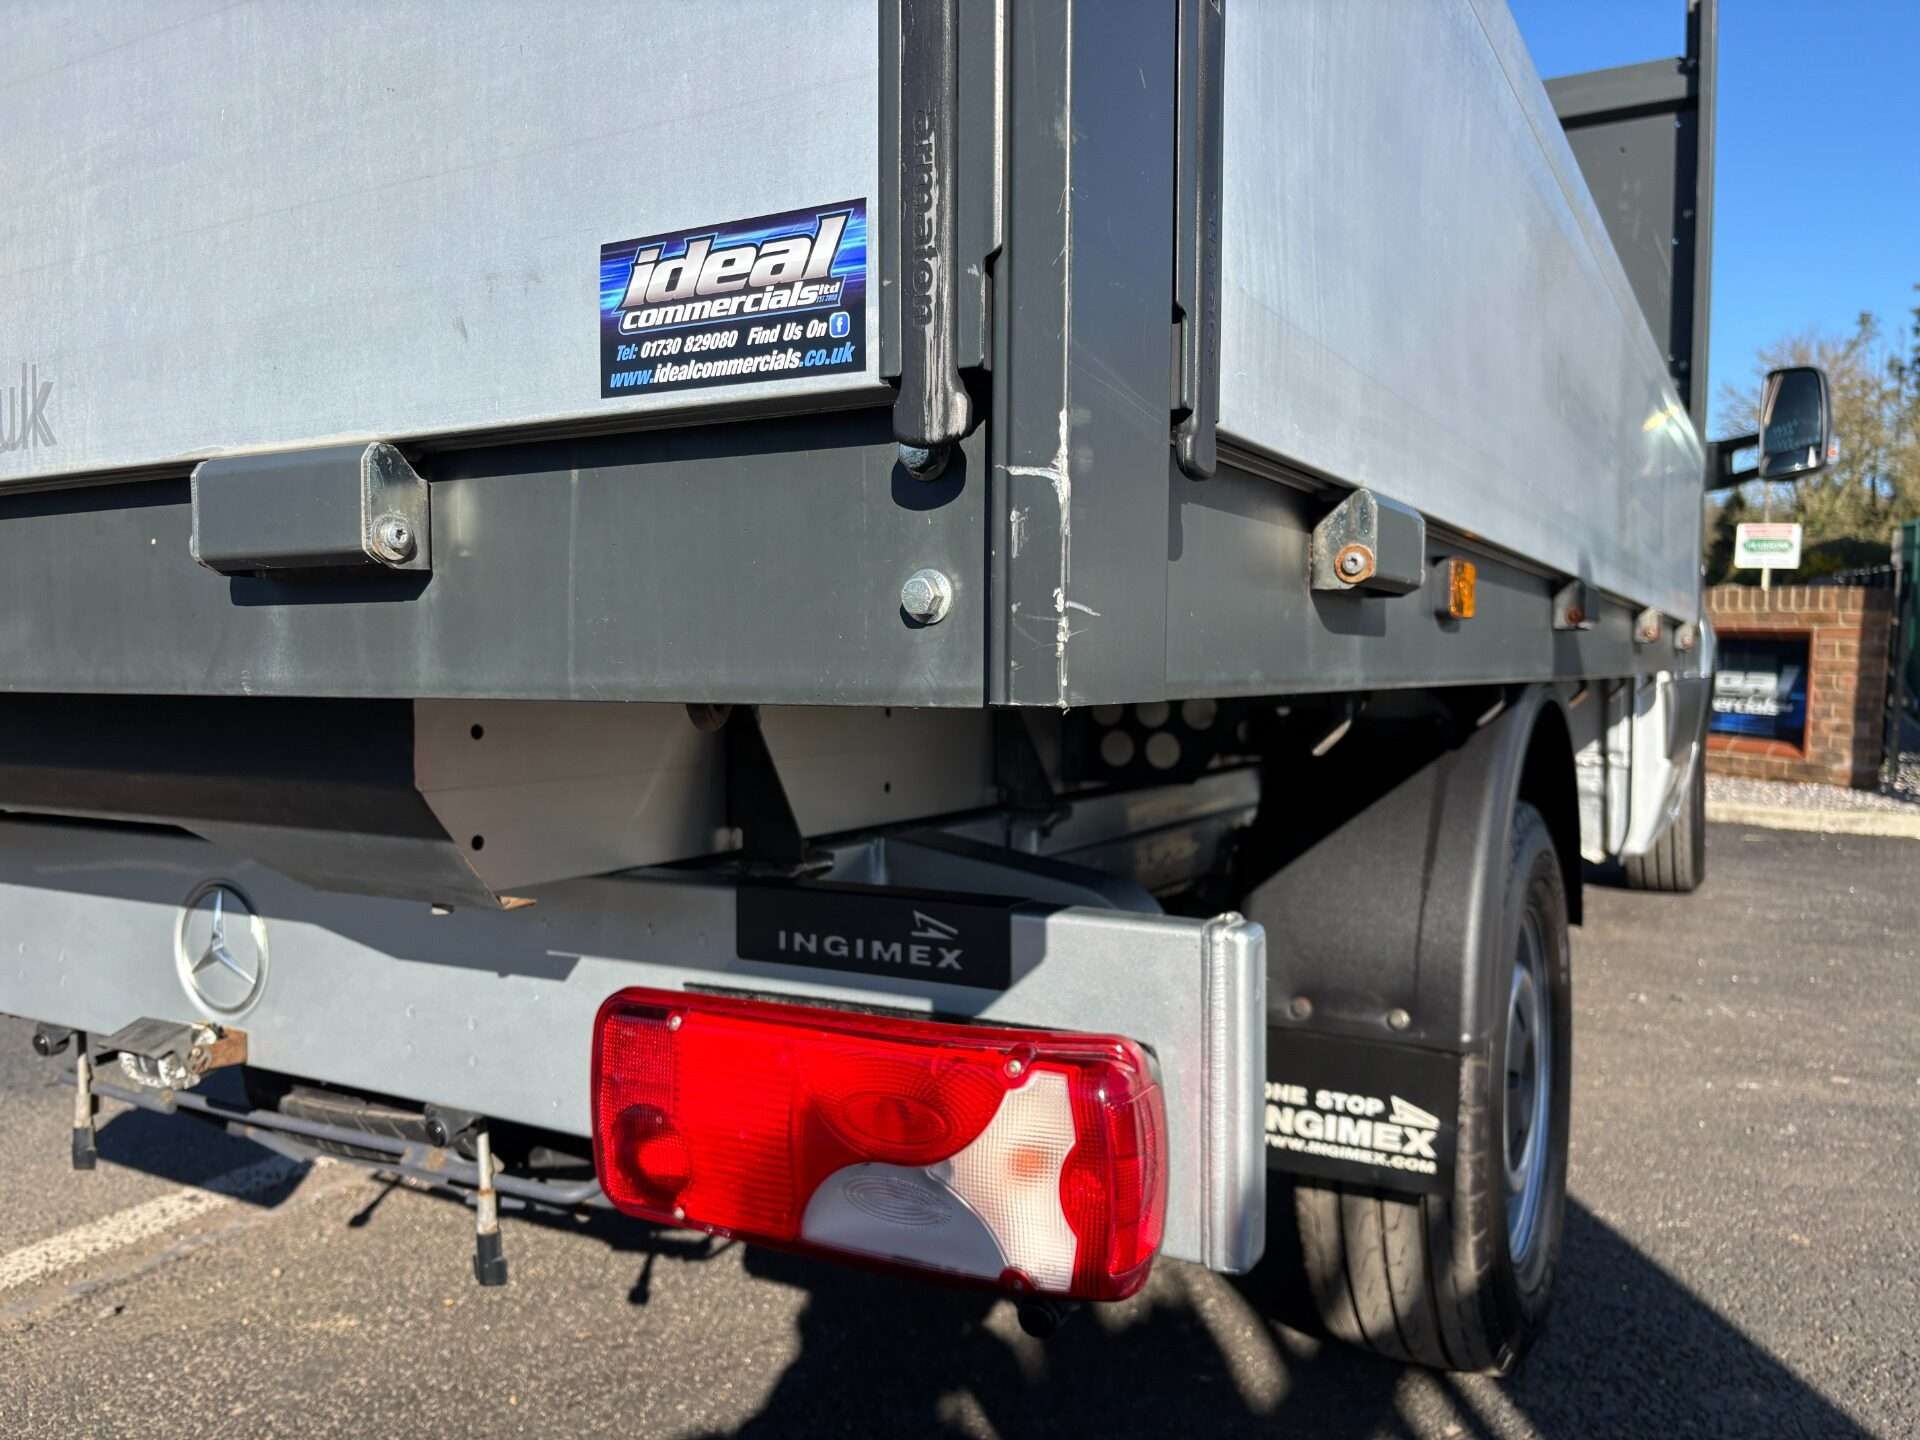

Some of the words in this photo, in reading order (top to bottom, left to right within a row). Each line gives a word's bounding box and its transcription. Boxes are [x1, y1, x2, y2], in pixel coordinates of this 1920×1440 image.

[622, 215, 848, 308] ideal
[622, 283, 819, 330] commercials
[616, 343, 638, 362] Tel:
[640, 338, 680, 359] 01730
[683, 330, 739, 353] 829080
[747, 324, 780, 346] Find
[783, 320, 803, 341] Us
[806, 319, 828, 338] On
[610, 342, 855, 389] www.idealcommercials.co.uk
[778, 930, 964, 970] INGIMEX
[1315, 1089, 1386, 1117] STOP
[1264, 1104, 1438, 1159] NGIMEX
